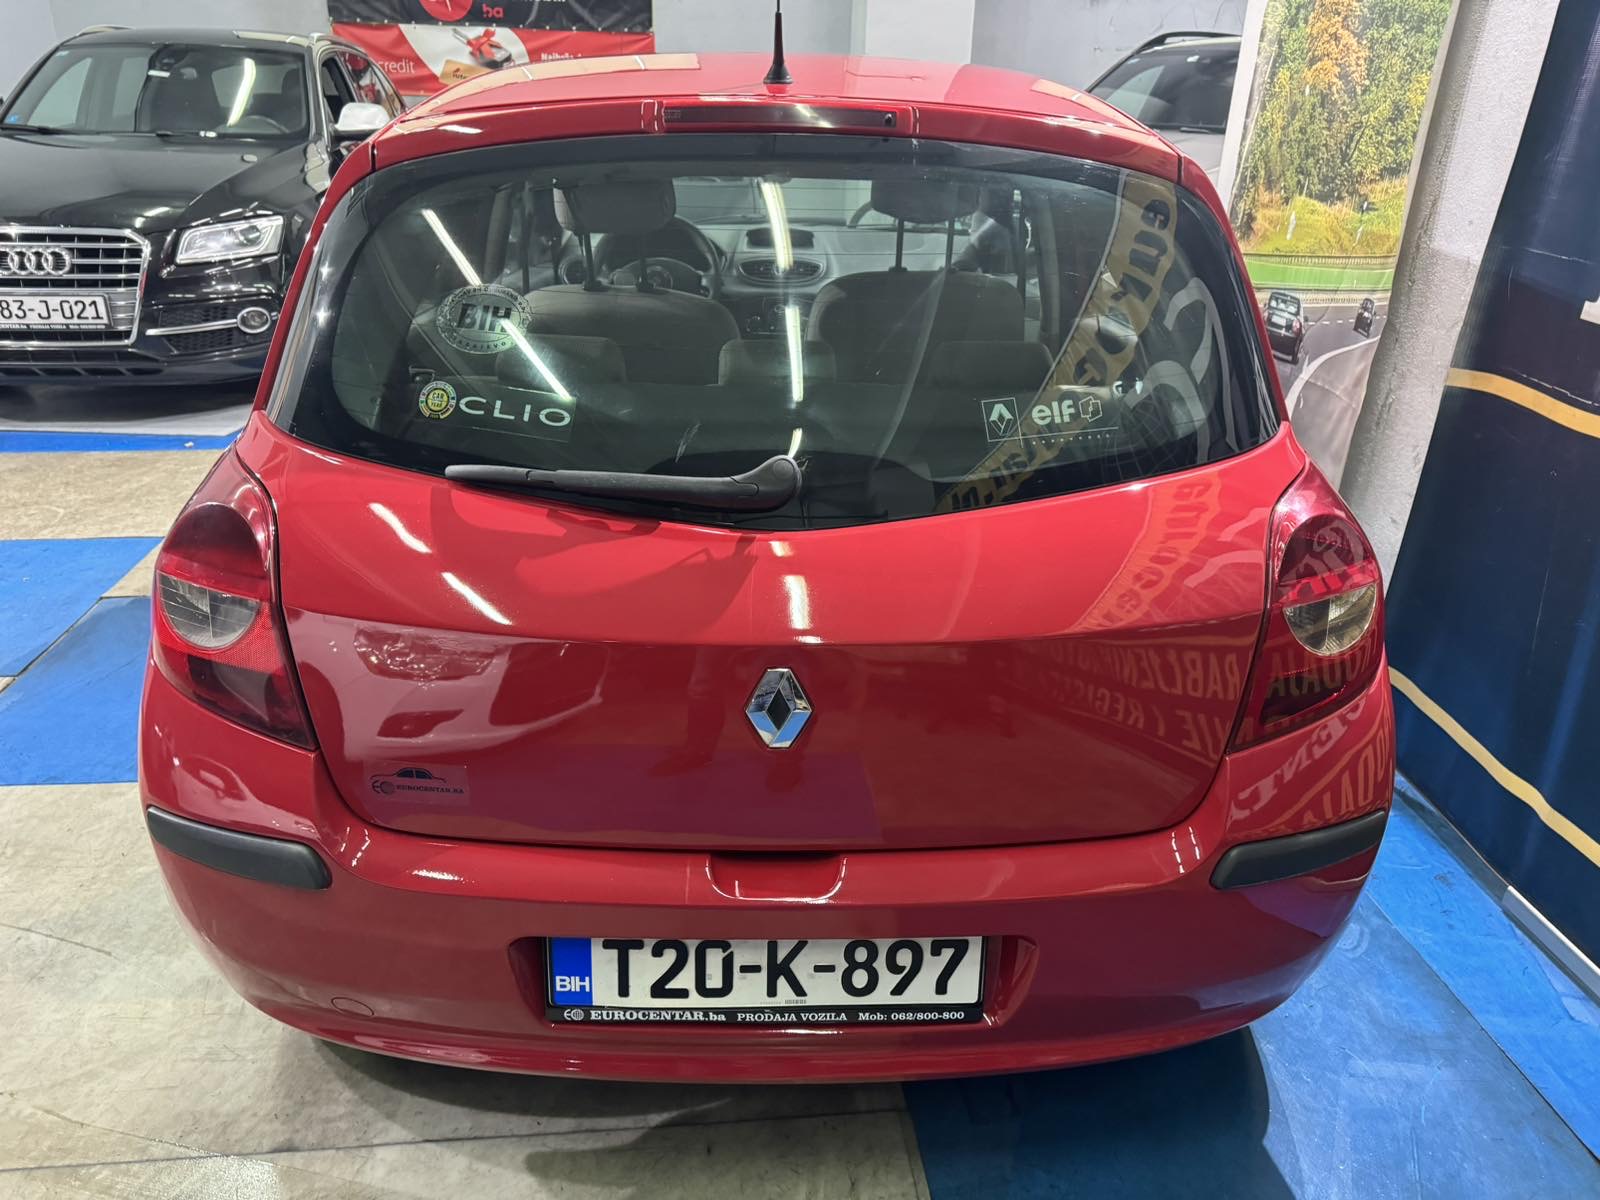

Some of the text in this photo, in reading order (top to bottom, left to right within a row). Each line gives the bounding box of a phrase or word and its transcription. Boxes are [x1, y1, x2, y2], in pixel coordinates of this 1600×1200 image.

[378, 58, 416, 74] redit
[459, 396, 572, 427] CLIO
[1031, 399, 1076, 426] elf
[602, 939, 970, 999] T20-K-897
[555, 975, 590, 992] BIH
[590, 1010, 965, 1022] EUROCENTAR.ba PRODAJA VOZILA Mob: 062/800-800
